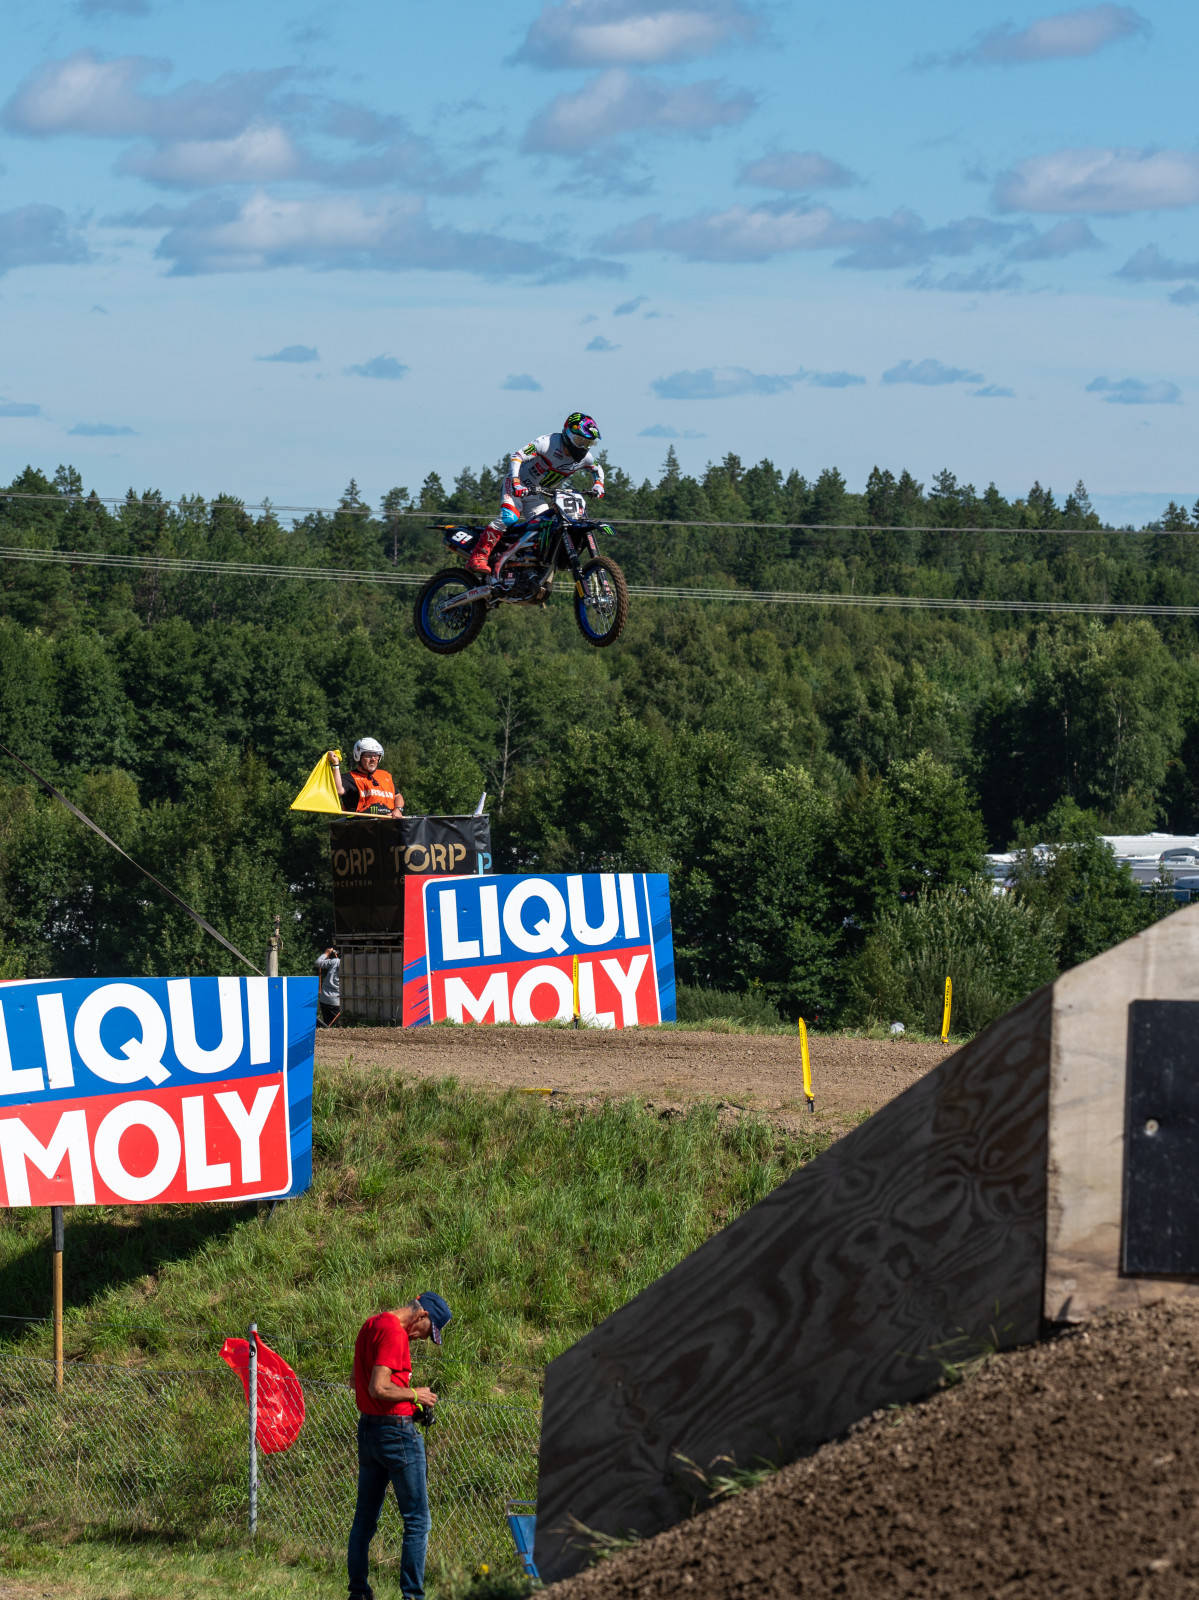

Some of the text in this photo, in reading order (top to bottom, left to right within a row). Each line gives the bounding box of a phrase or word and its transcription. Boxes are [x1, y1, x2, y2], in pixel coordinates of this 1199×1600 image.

[452, 531, 473, 542] 91
[331, 847, 374, 877] ORP
[390, 844, 467, 872] TORP
[439, 874, 640, 961] LIQUI
[444, 954, 649, 1029] MOLY
